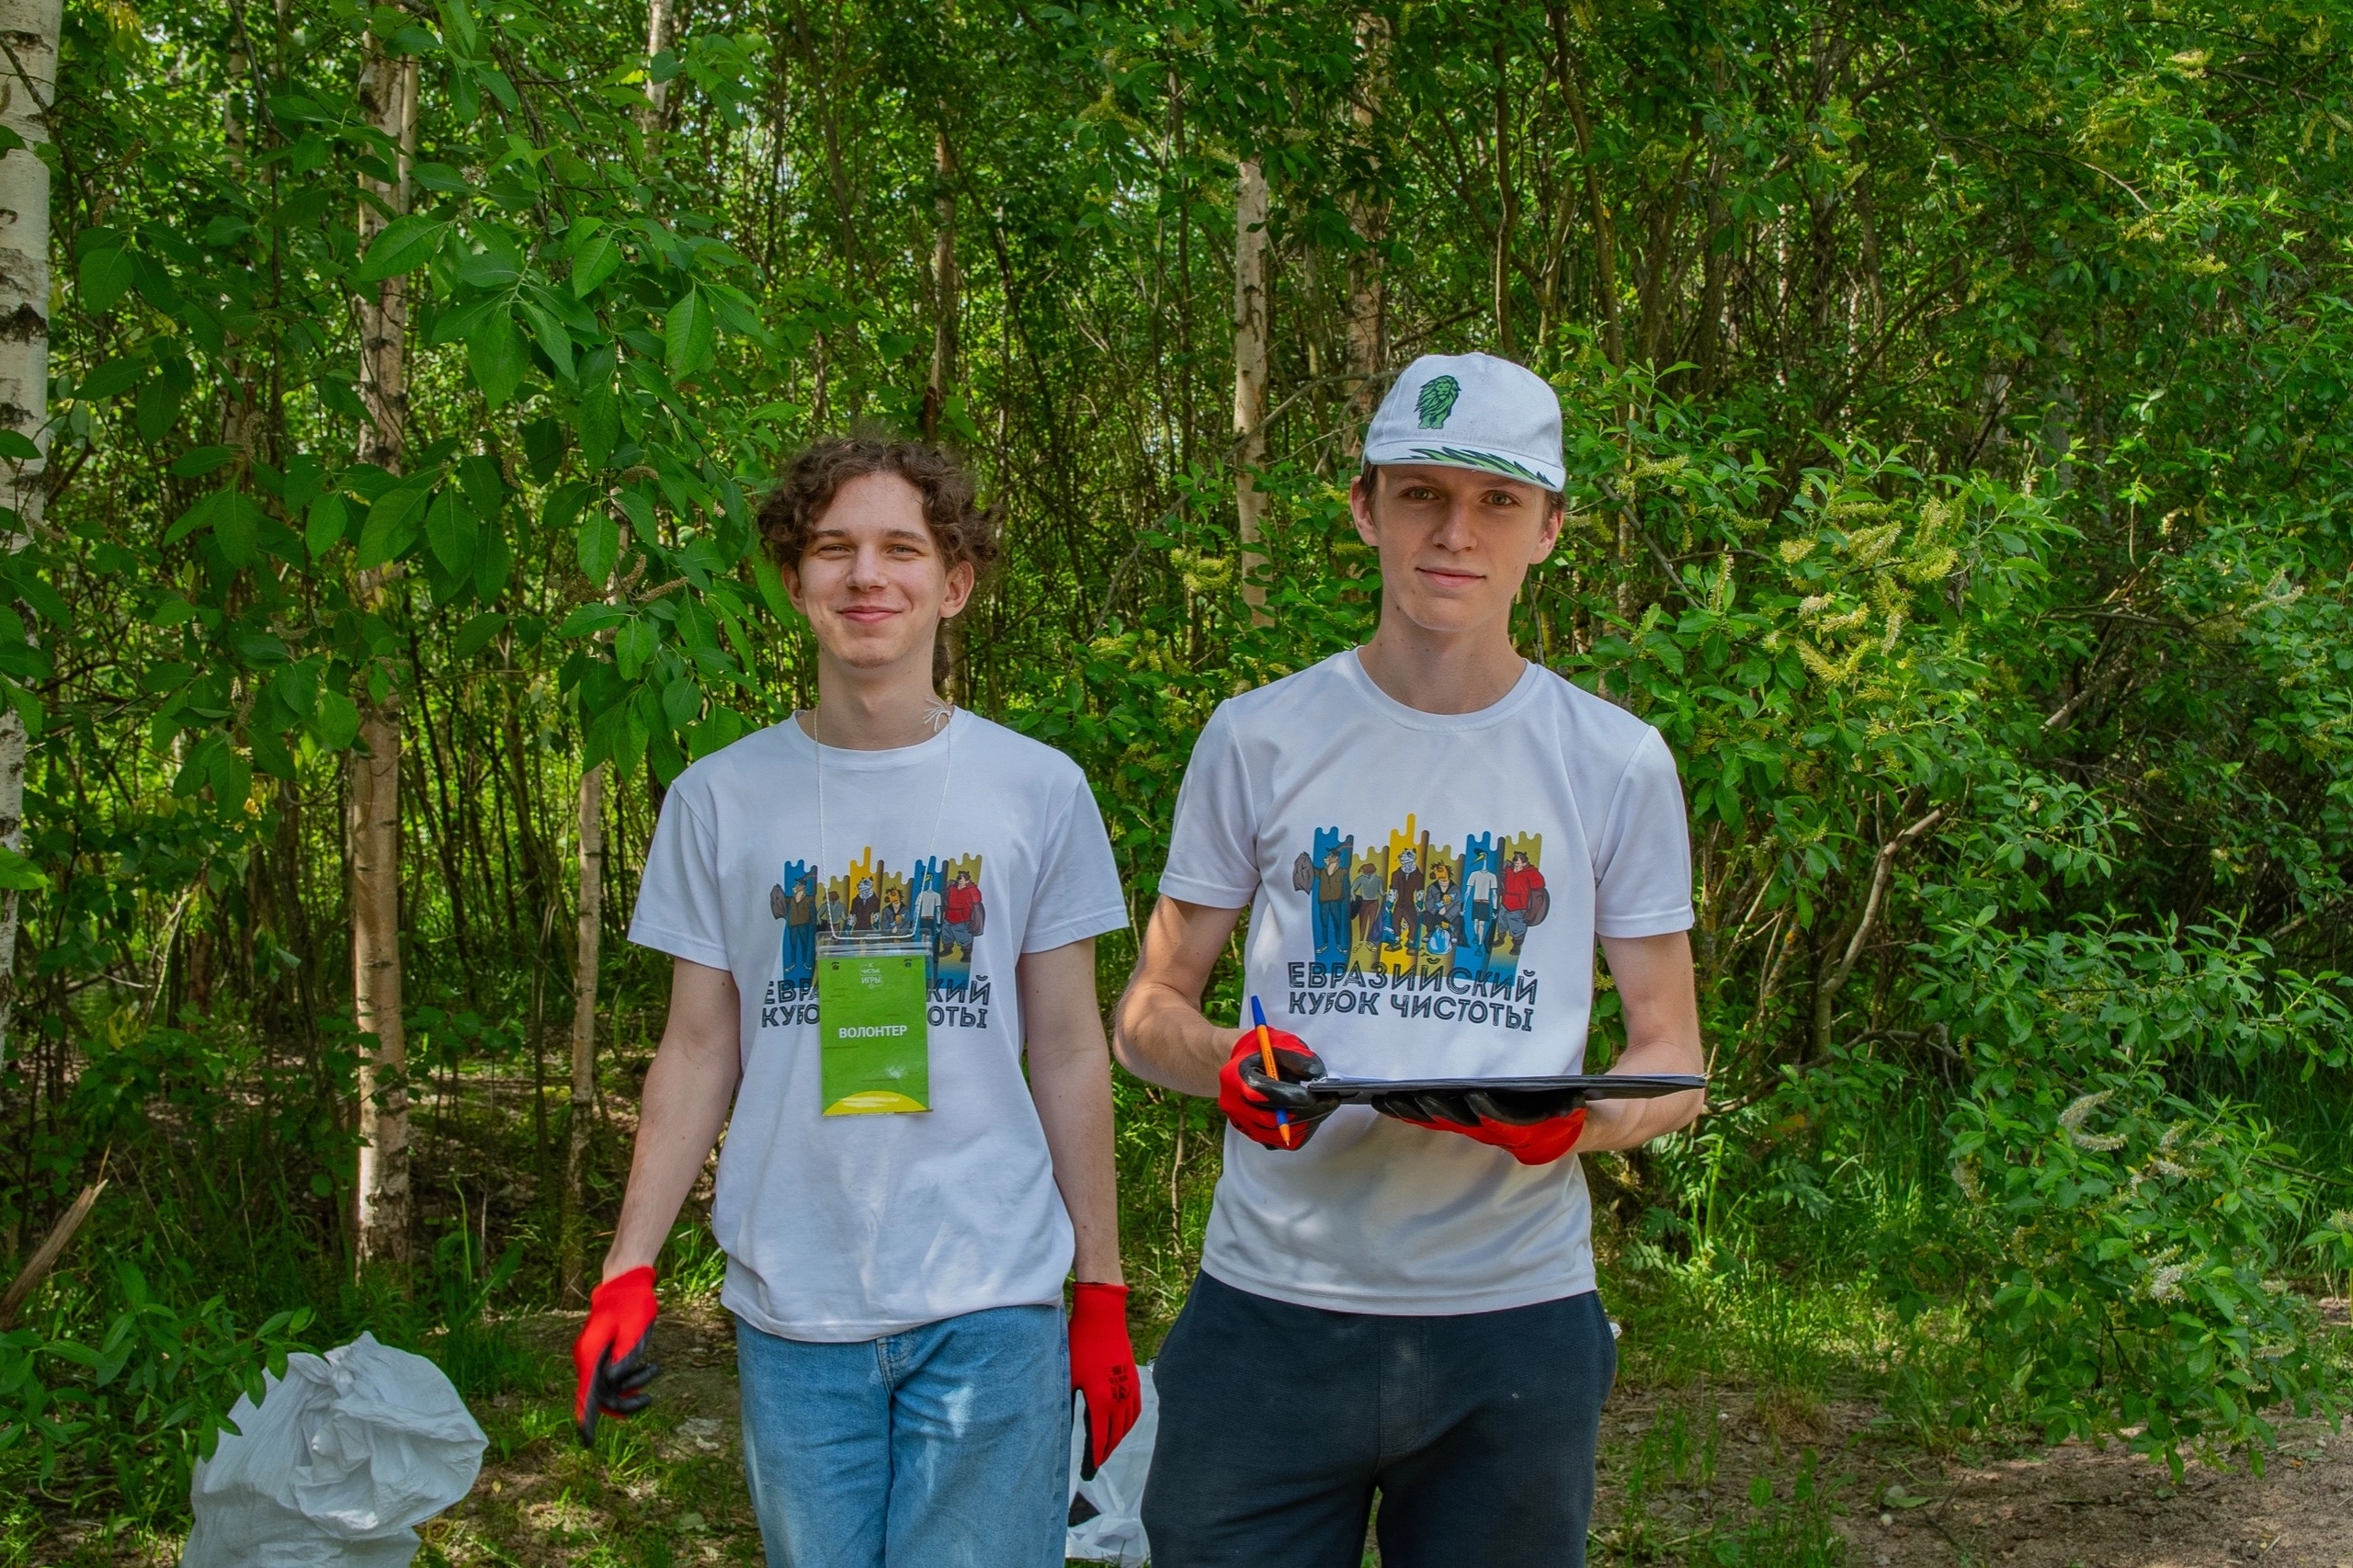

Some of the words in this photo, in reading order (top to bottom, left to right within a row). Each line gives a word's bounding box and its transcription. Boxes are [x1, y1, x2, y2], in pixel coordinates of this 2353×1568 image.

[861, 976, 881, 984] ИГРЫ
[1288, 958, 1538, 1006] ЕВРАЗИЙСКИЙ
[761, 1004, 821, 1028] КУБО
[1289, 990, 1381, 1016] КУБОК
[1390, 994, 1534, 1031] ЧИСТОТЫ
[838, 1025, 908, 1039] ВОЛОНТЕР
